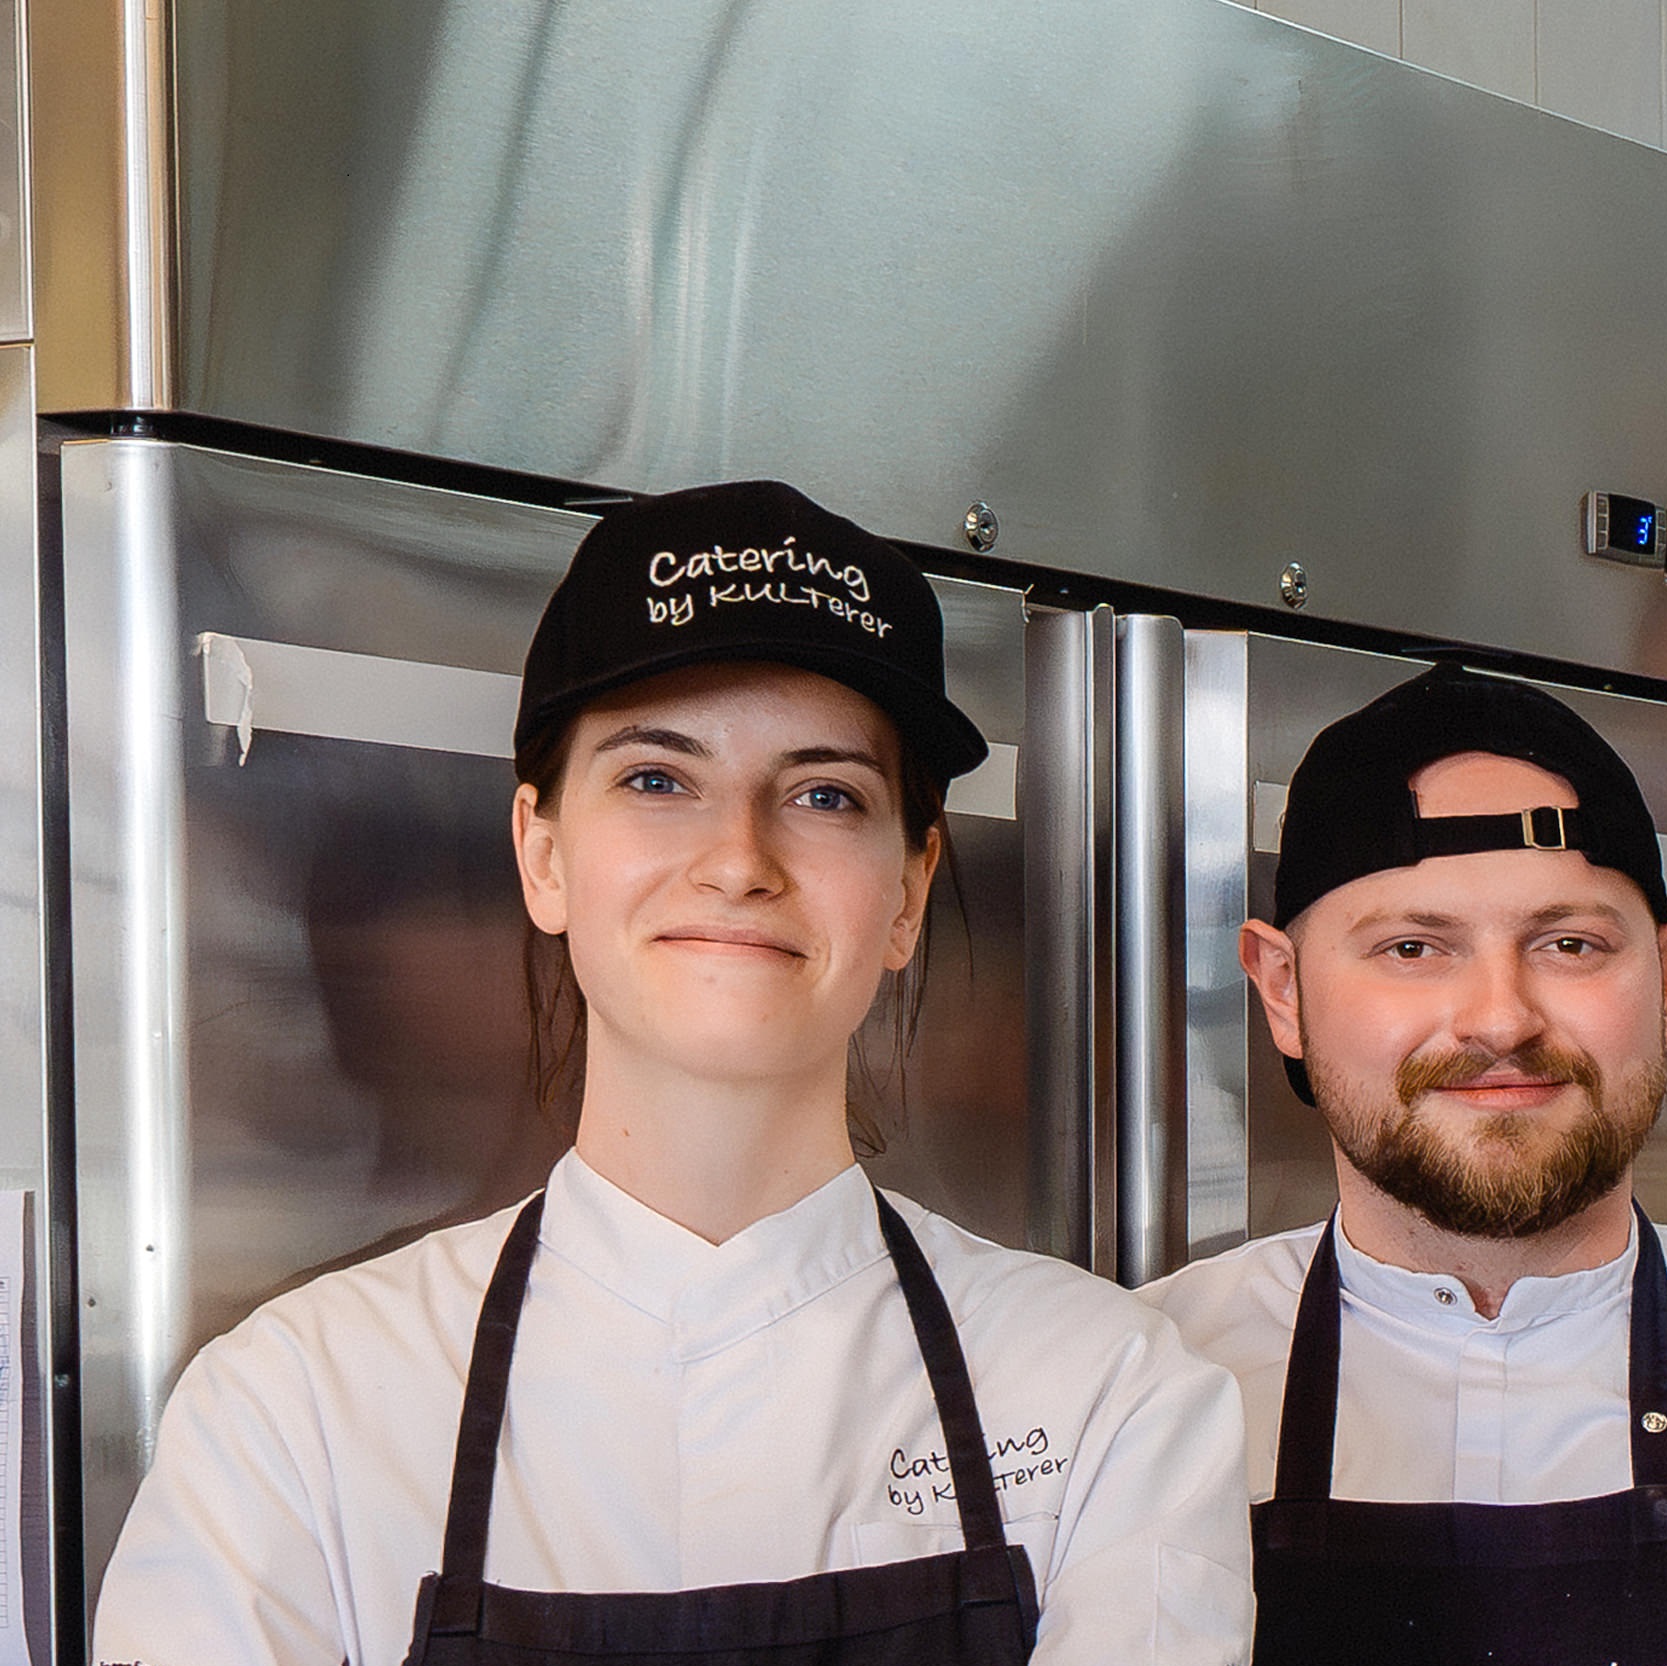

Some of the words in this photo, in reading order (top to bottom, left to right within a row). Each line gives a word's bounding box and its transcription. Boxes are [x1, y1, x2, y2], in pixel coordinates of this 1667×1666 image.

[649, 536, 871, 602] Catering
[647, 593, 694, 626] by
[709, 582, 893, 638] KULTerer
[888, 1484, 924, 1516] by
[931, 1457, 1069, 1504] KTerer
